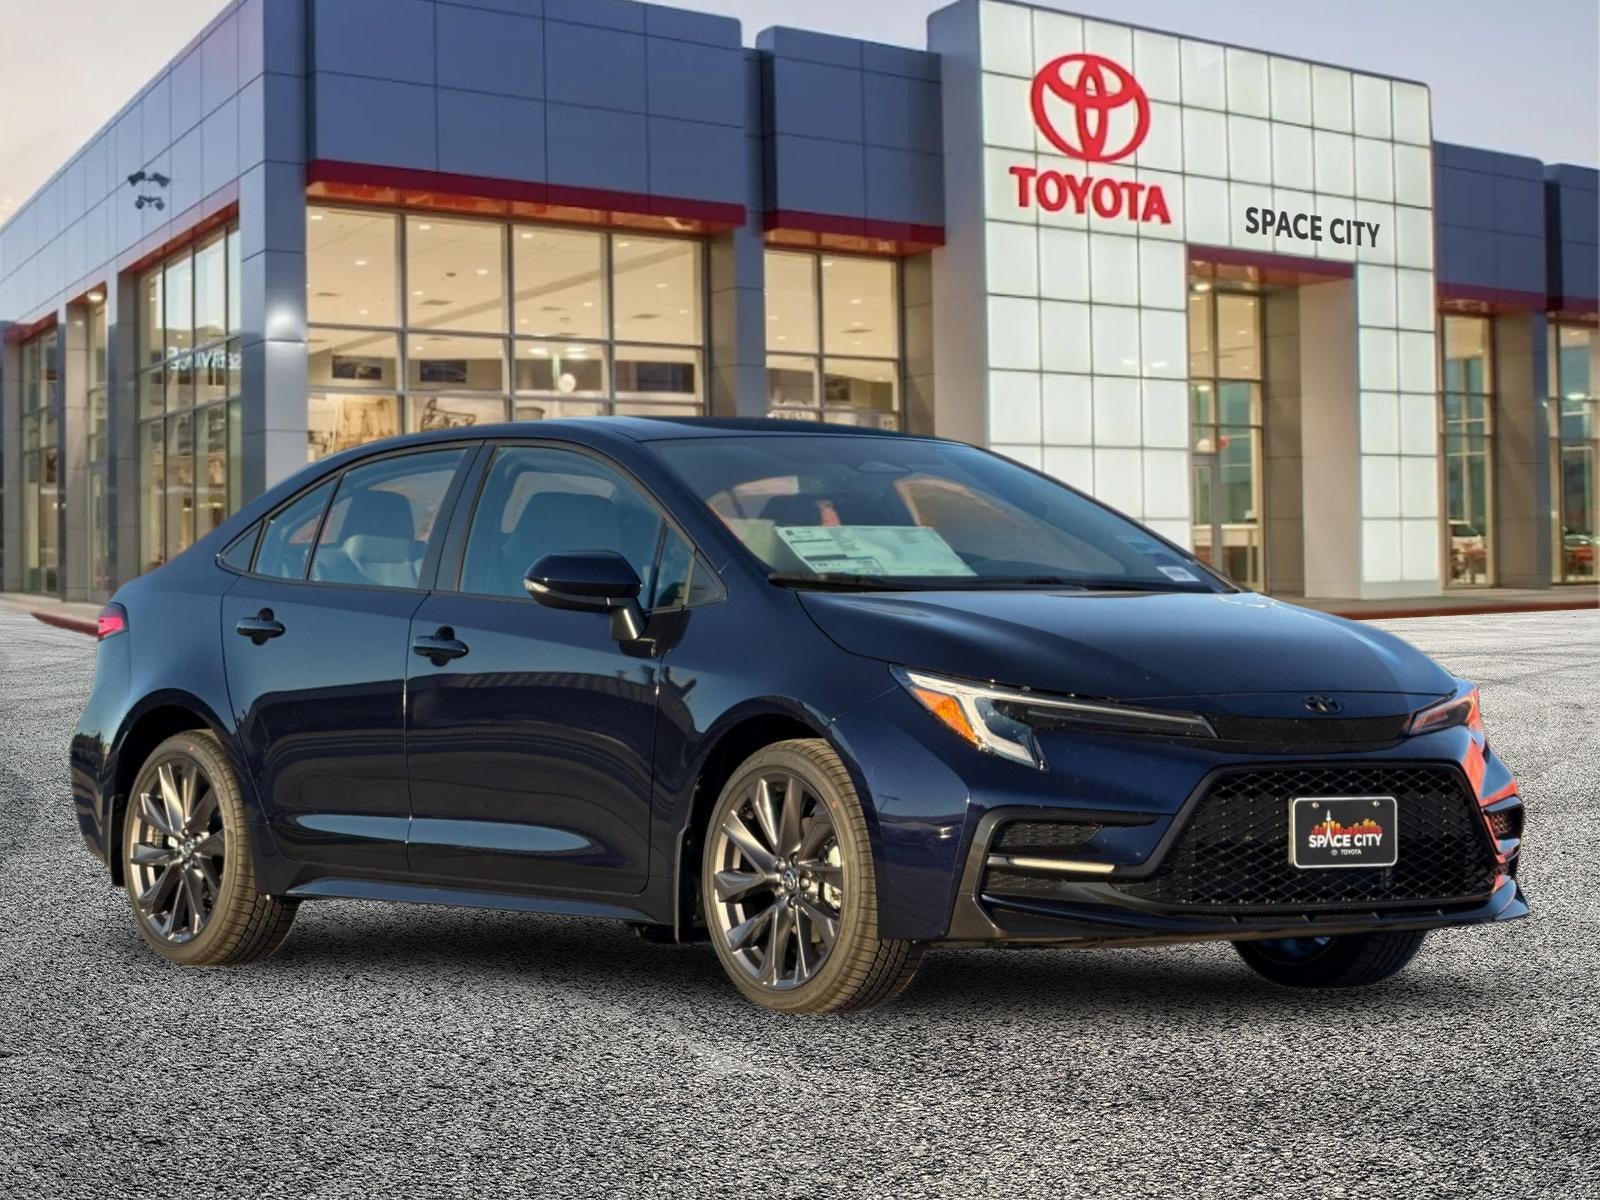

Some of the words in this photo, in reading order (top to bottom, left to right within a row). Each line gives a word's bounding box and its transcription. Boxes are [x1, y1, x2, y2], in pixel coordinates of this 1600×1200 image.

[1009, 166, 1171, 225] TOYOTA
[1245, 206, 1323, 242] SPACE
[1330, 217, 1381, 248] CITY
[1308, 832, 1351, 848] SPACE
[1354, 832, 1383, 847] CITY
[1340, 848, 1362, 856] TOYOTA
